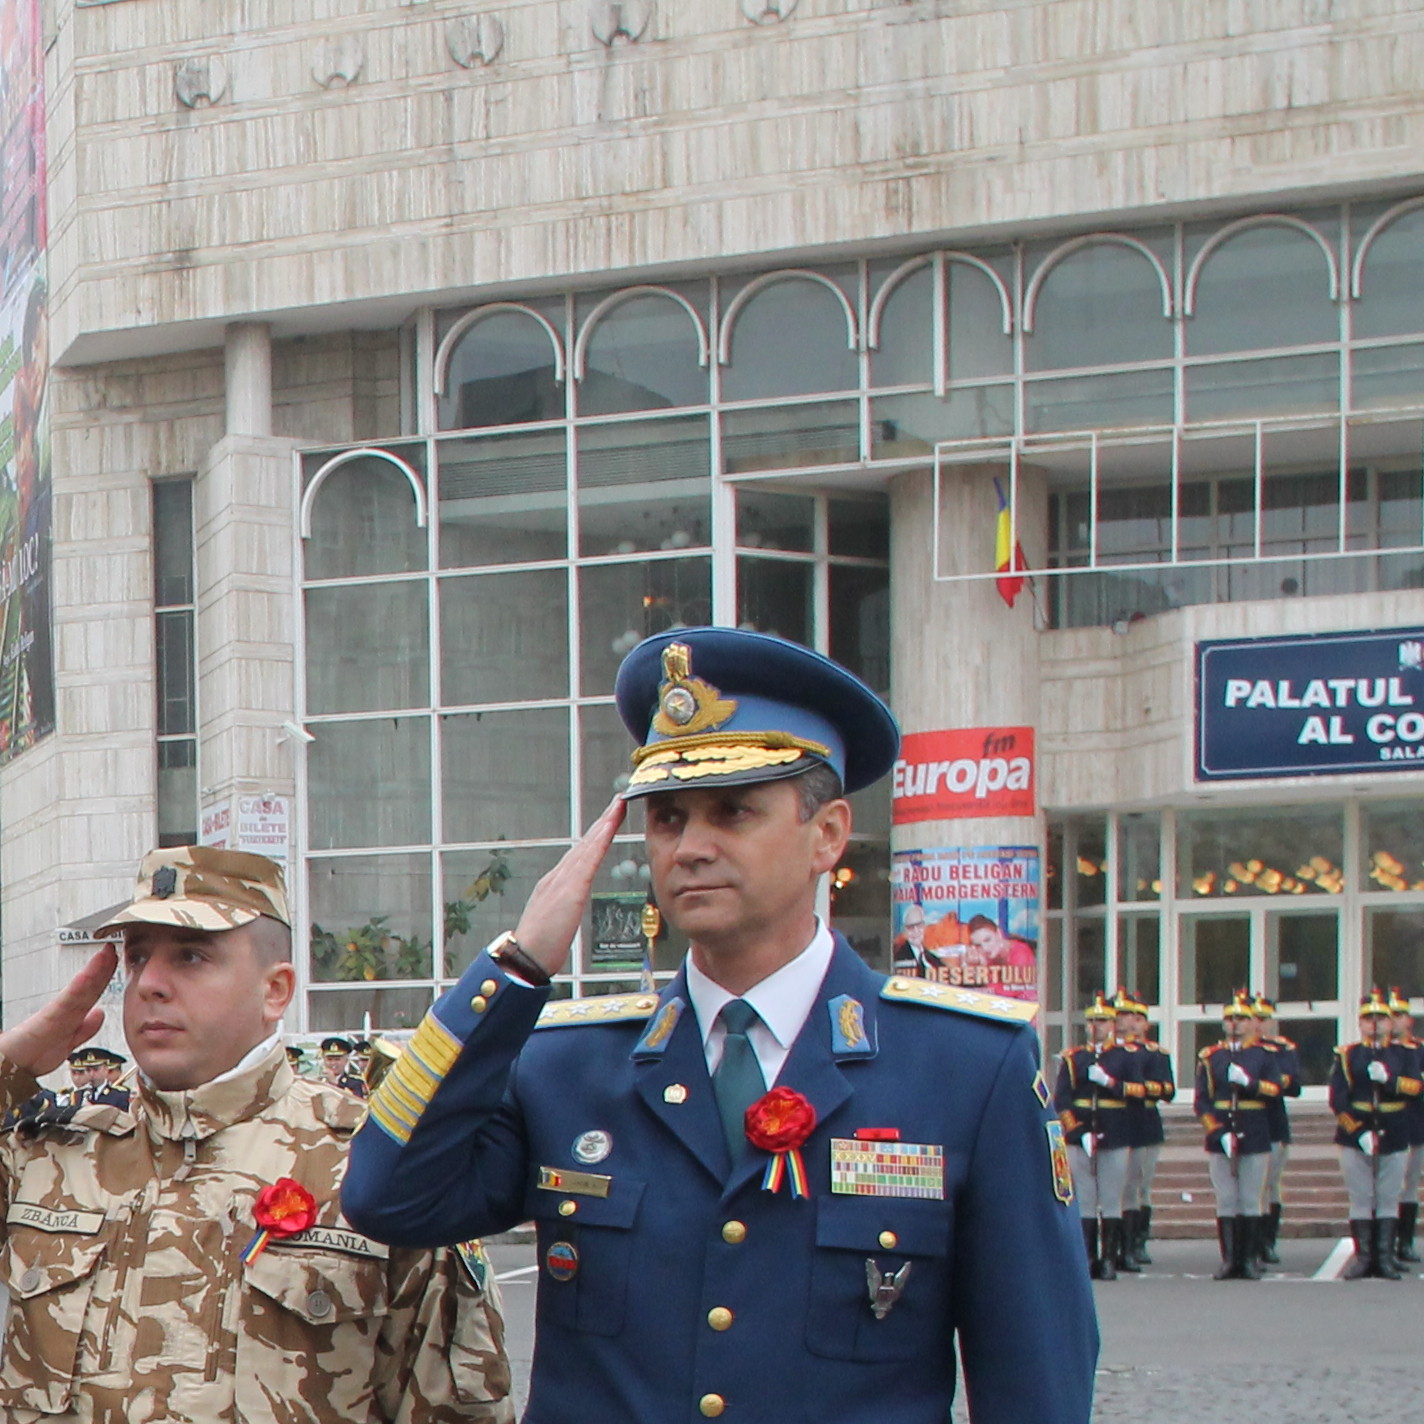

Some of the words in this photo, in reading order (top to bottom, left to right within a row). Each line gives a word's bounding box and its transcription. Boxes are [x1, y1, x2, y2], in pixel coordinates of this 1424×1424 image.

[1225, 677, 1414, 708] PALATUL
[1298, 715, 1355, 745] AL
[983, 732, 1016, 757] fm
[892, 756, 1031, 799] Europa
[240, 801, 284, 814] CASA
[240, 823, 286, 832] BILETE
[903, 866, 942, 883] RADU
[948, 863, 1024, 881] BELIGAN
[920, 882, 1038, 901] MORGENSTERN
[58, 930, 90, 942] CASA
[290, 1230, 371, 1252] OMANIA
